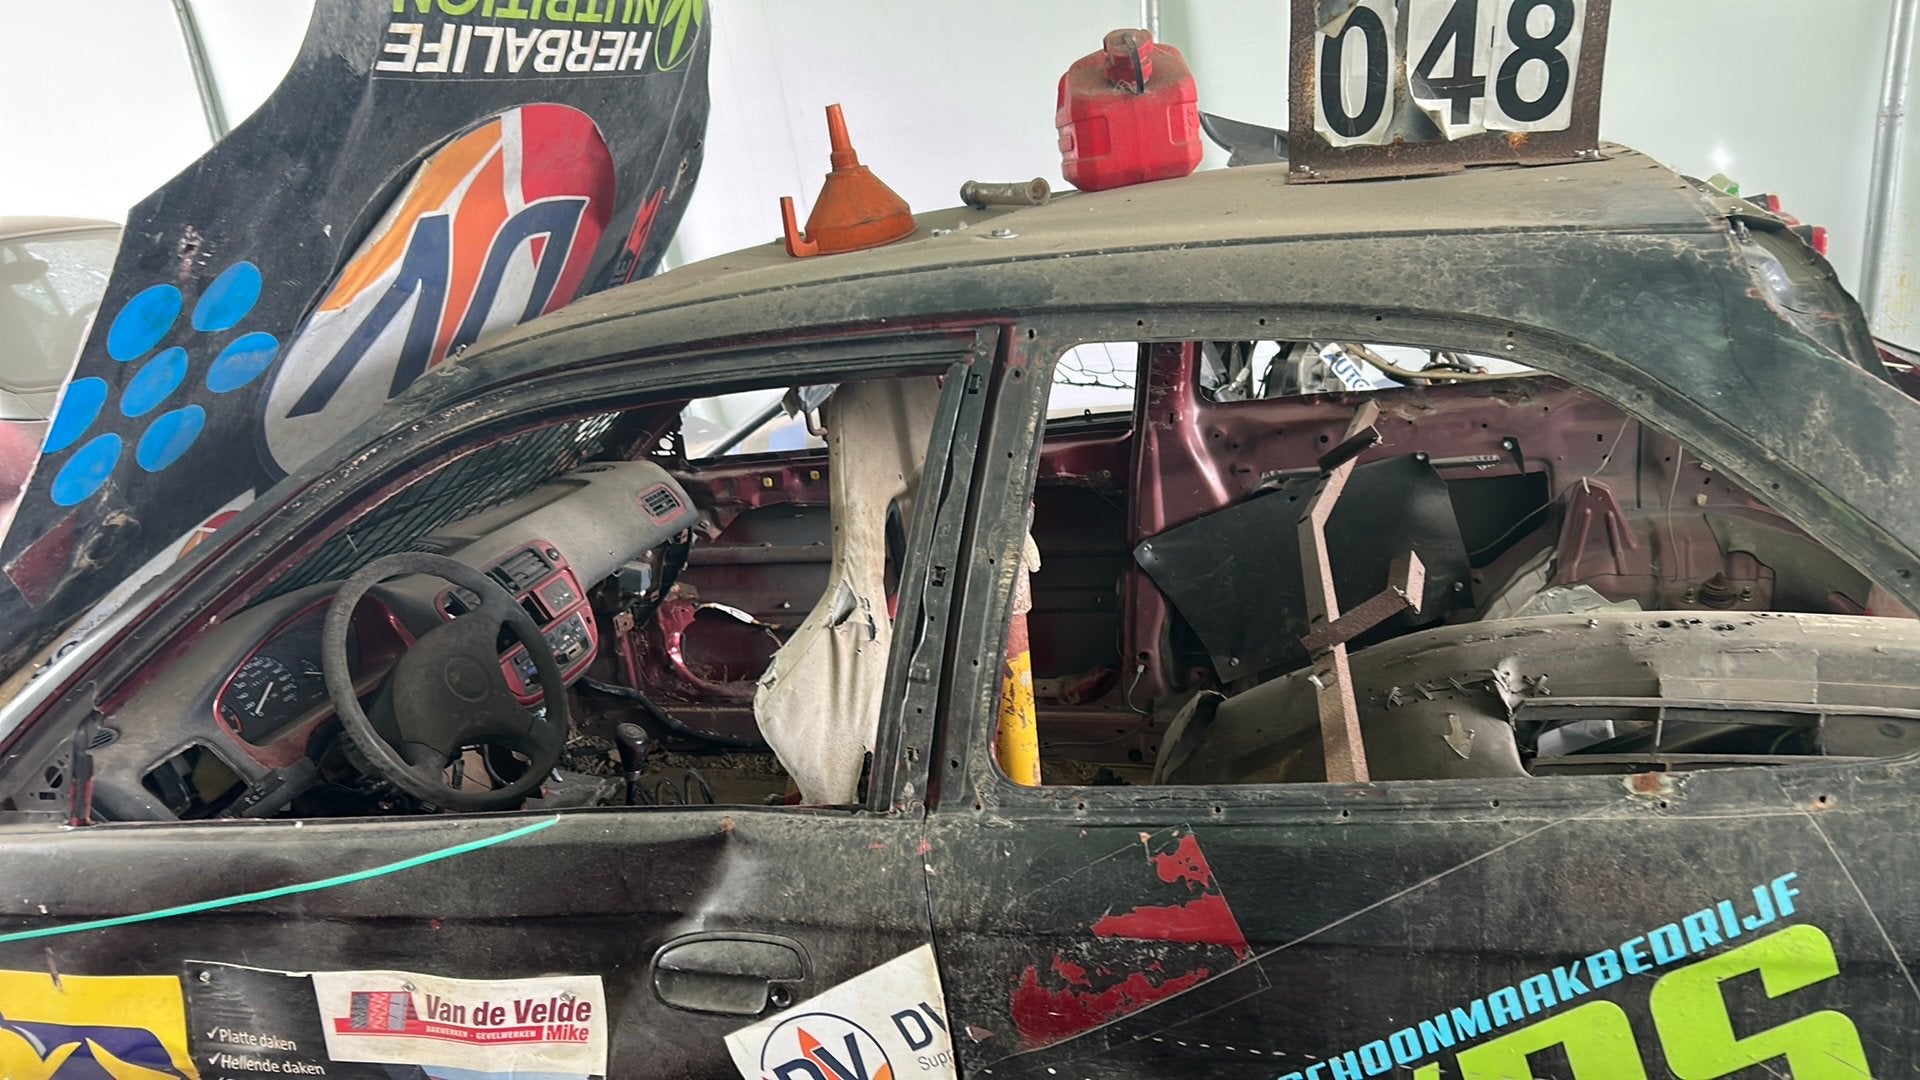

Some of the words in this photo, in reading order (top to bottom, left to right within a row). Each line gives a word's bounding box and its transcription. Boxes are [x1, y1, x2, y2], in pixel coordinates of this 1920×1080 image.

[375, 23, 653, 74] HERBALIFE
[1320, 0, 1575, 138] 048
[1276, 872, 1800, 1080] CHOONMAAKBEDRIJF
[426, 994, 466, 1025] Van
[472, 1001, 506, 1026] de
[513, 996, 592, 1024] Velde
[220, 1028, 258, 1046] Platte
[259, 1033, 297, 1051] daken
[546, 1025, 589, 1041] Mike
[220, 1054, 280, 1073] Hellende
[282, 1061, 326, 1075] daken
